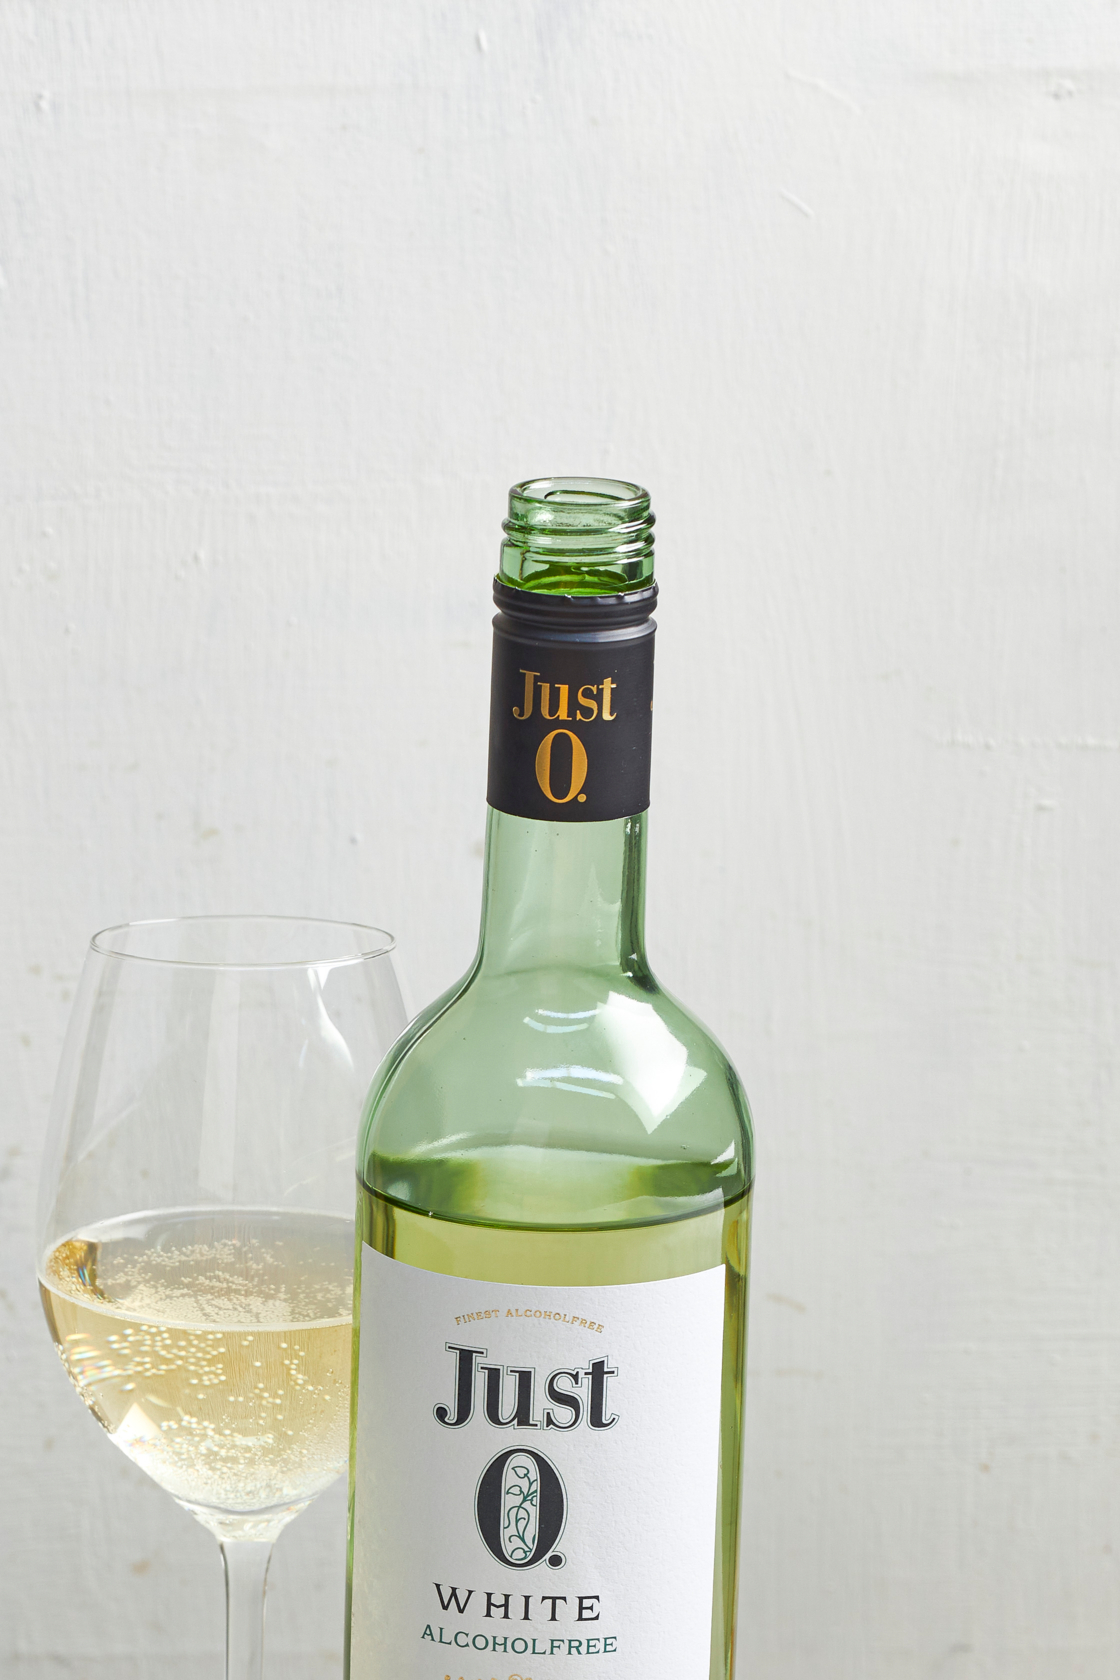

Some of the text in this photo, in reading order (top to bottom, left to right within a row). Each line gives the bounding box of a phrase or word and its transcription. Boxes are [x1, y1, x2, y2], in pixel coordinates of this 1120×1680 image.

[512, 668, 618, 722] Just
[454, 1308, 605, 1334] FINEST ALCOHOLFREE
[433, 1340, 620, 1430] Just
[432, 1581, 601, 1622] WHITE
[420, 1623, 618, 1656] ALCOHOLFREE
